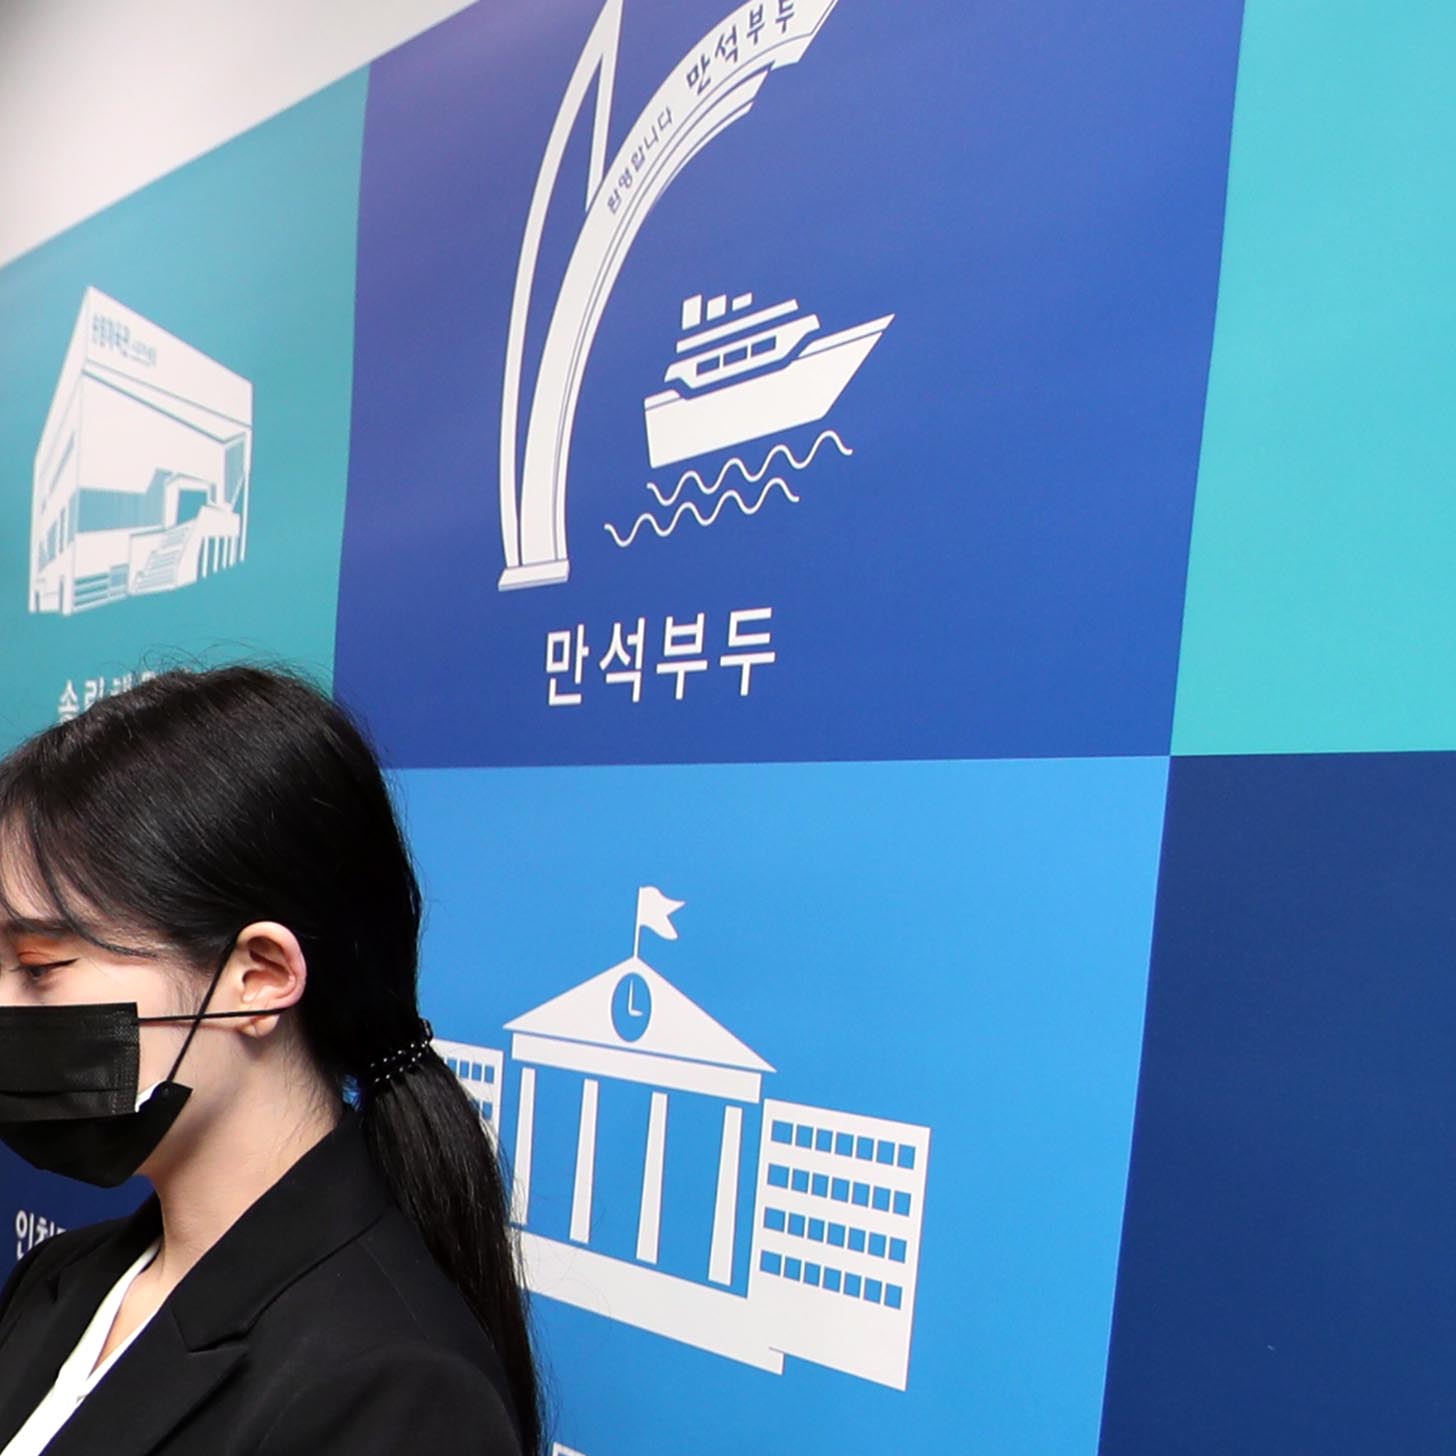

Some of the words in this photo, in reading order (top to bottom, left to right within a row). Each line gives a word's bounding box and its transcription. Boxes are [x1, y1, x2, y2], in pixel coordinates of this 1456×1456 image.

[686, 0, 795, 95] 만석부두
[545, 607, 777, 707] 만석부두
[15, 1209, 67, 1261] 인천
